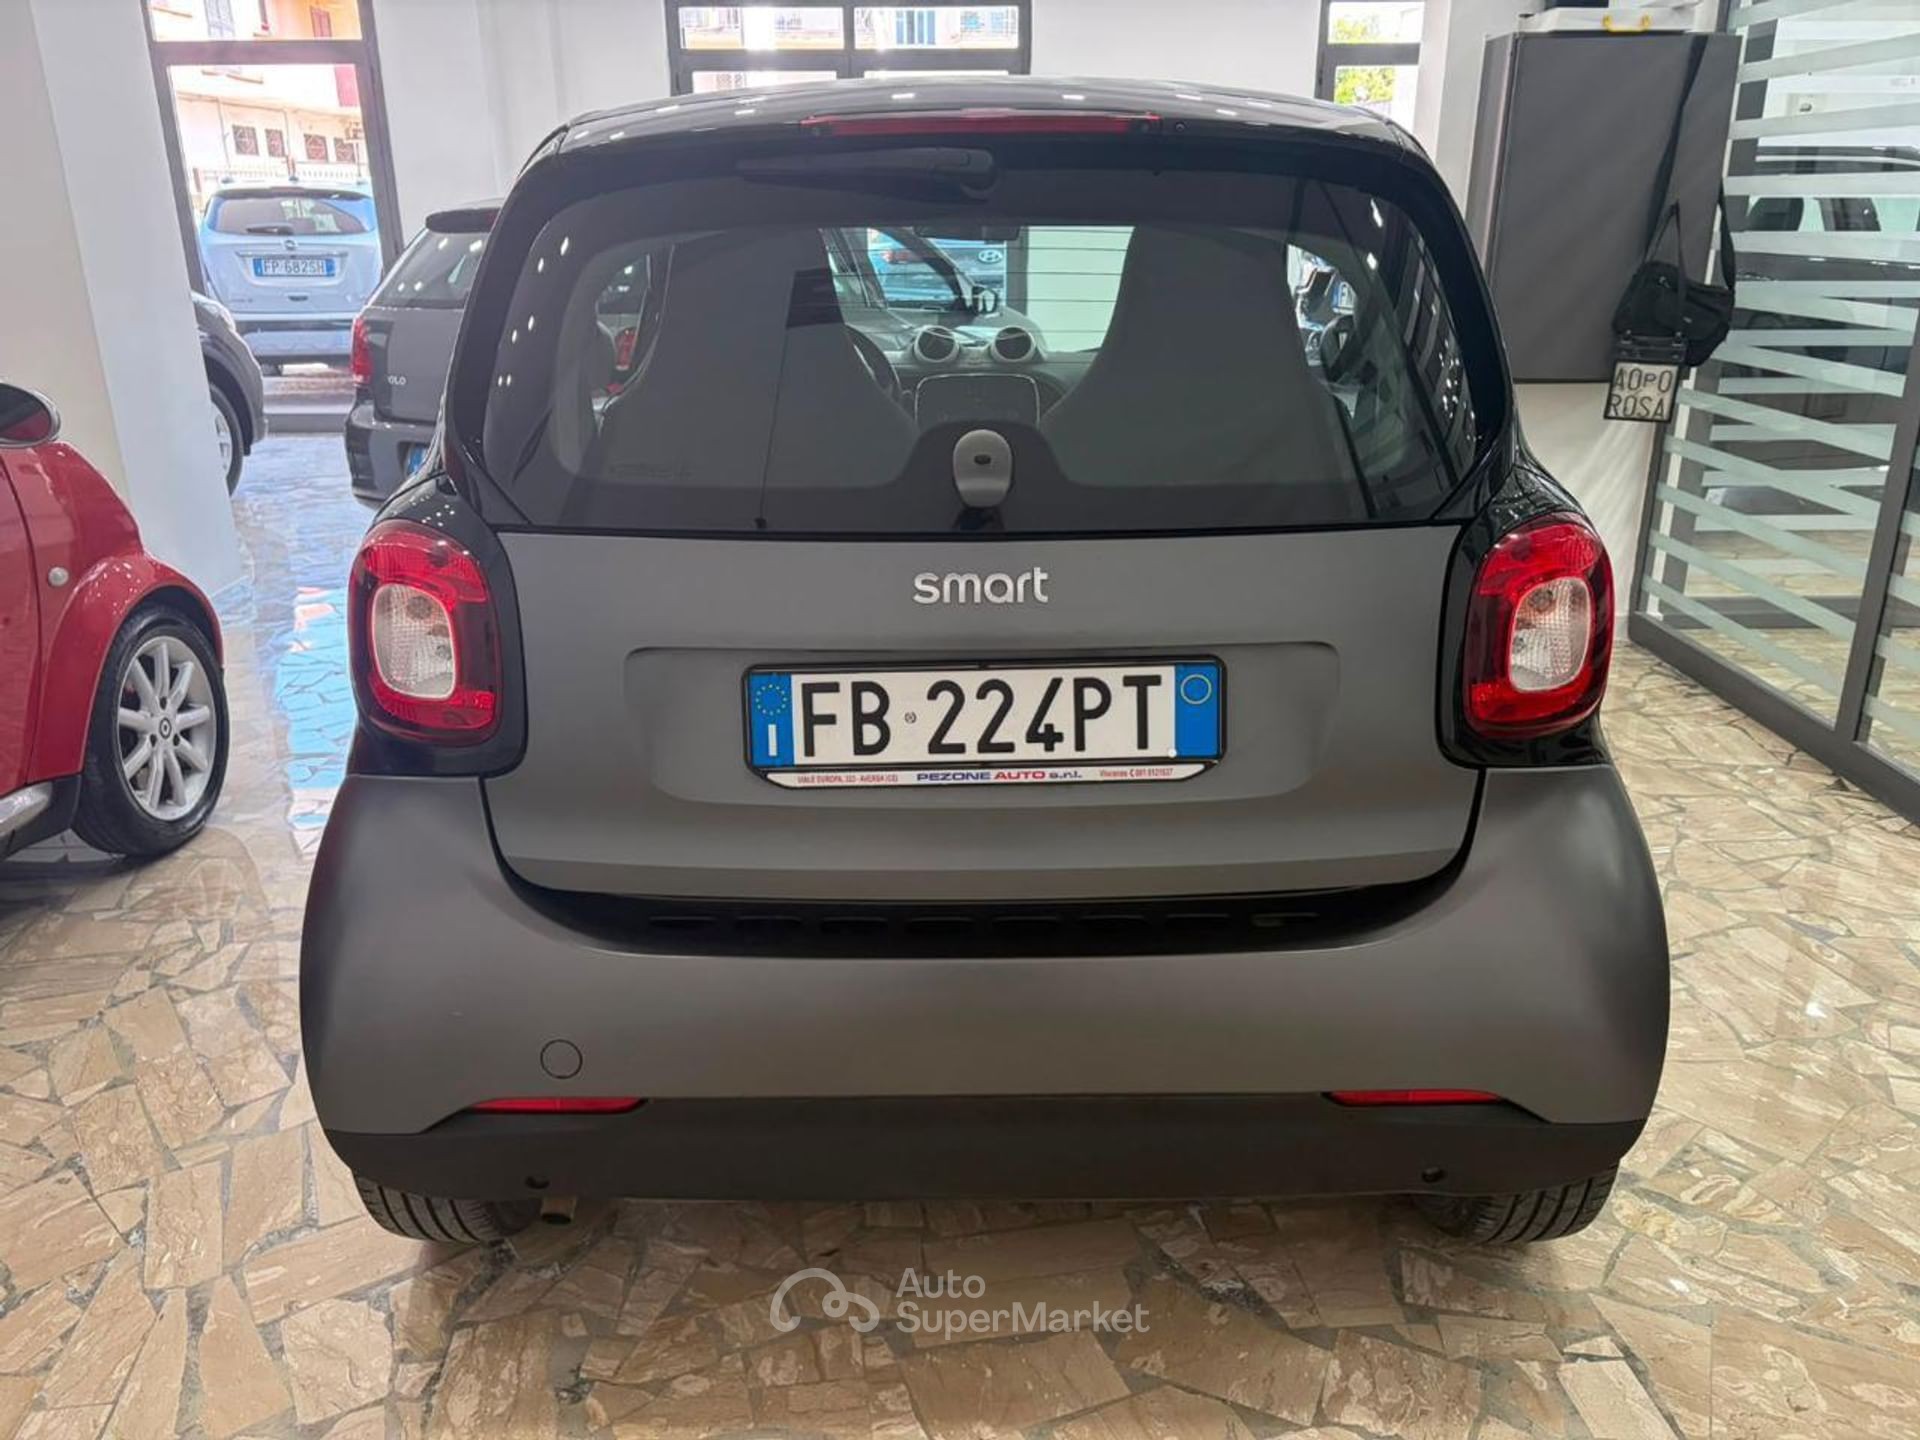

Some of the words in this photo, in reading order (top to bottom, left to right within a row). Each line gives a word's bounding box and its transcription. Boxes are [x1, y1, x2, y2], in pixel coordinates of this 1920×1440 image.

[913, 567, 1049, 604] smart
[801, 681, 891, 757] FB
[927, 675, 1162, 754] 224PT
[917, 772, 991, 781] PEZONE
[994, 771, 1046, 781] AUTO
